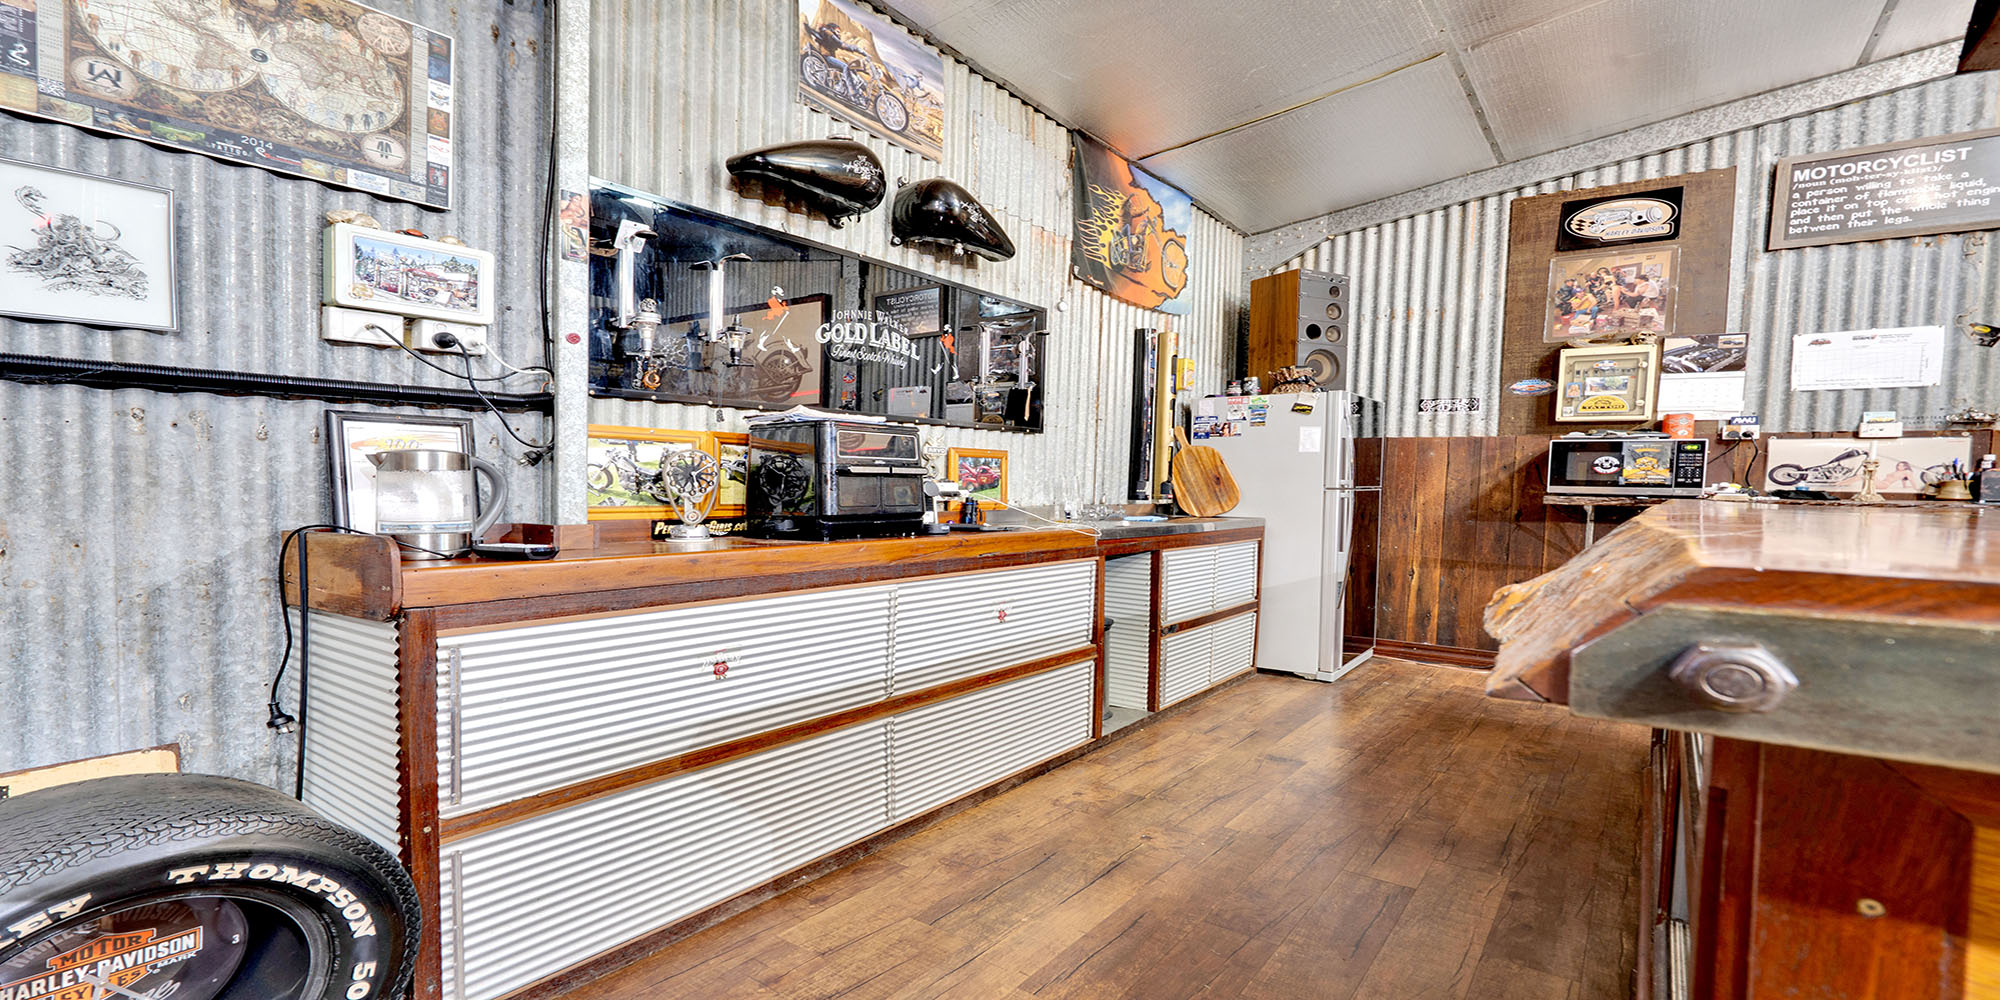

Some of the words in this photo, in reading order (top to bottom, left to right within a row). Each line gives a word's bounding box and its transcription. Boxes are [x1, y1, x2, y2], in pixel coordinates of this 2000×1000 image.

[241, 135, 273, 150] 2014
[1793, 147, 1973, 182] MOTORCYCLIST
[1791, 195, 1848, 208] container
[1854, 191, 1870, 200] of
[1949, 178, 1987, 190] liquid,
[1806, 186, 1848, 199] person
[1855, 181, 1892, 191] willing
[1899, 178, 1915, 186] to
[1924, 172, 1953, 182] take
[1789, 216, 1811, 225] and
[1817, 213, 1844, 222] then
[1851, 209, 1872, 220] put
[1881, 206, 1902, 216] the
[1911, 201, 1948, 212] whole
[1956, 197, 1991, 208] thing
[1790, 207, 1820, 218] place
[1826, 204, 1837, 212] it
[1843, 202, 1859, 210] on
[1866, 199, 1889, 208] top
[1789, 223, 1840, 234] between
[1847, 219, 1878, 229] their
[1884, 215, 1913, 225] legs.
[831, 309, 873, 323] JOHNNIE
[876, 309, 909, 336] WALKER
[815, 322, 867, 345] GOLD
[869, 322, 920, 360] LABEL
[168, 862, 377, 938] THOMPSON
[345, 960, 377, 1000] 50
[232, 934, 240, 944] 3
[59, 934, 143, 967] MOTOR
[157, 952, 197, 968] MARK
